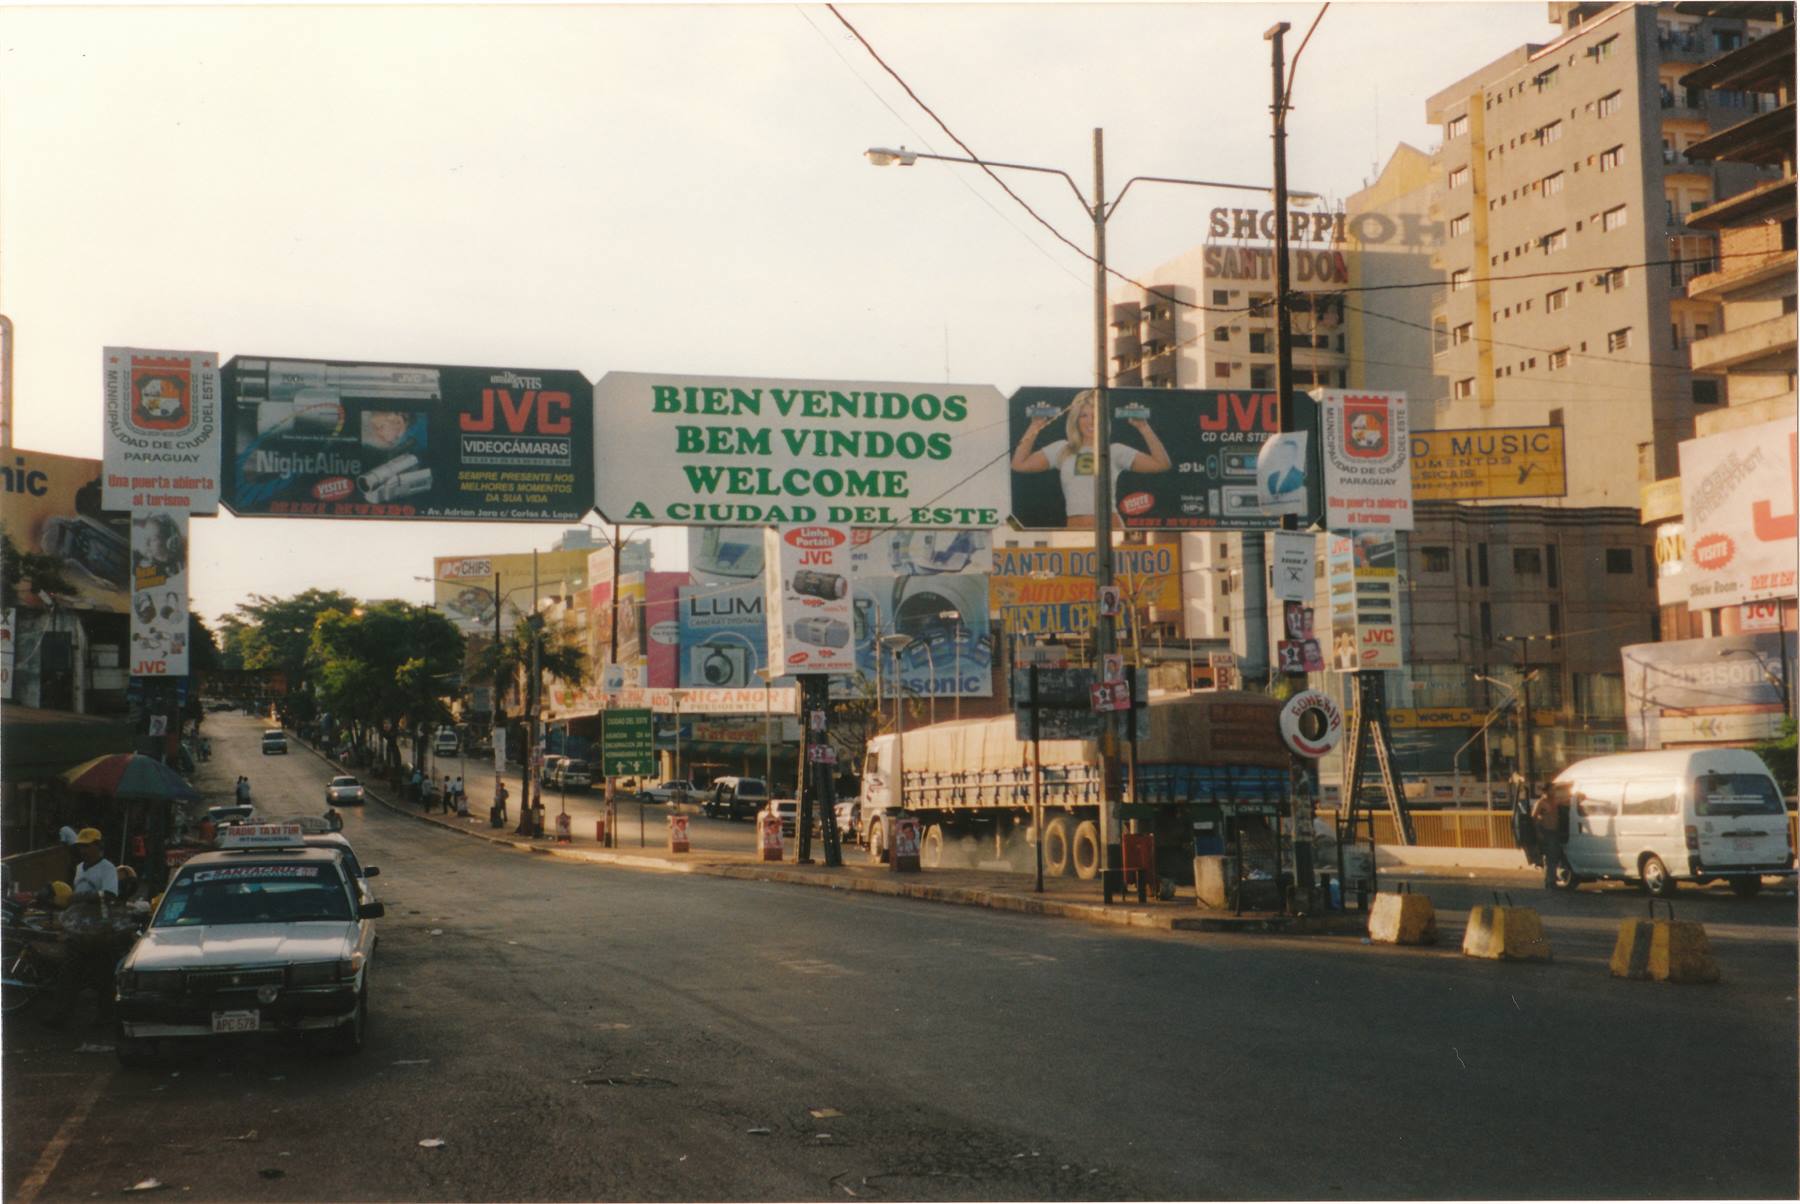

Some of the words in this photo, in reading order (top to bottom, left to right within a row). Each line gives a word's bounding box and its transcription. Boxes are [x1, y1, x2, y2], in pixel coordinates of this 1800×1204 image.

[202, 373, 214, 400] ESTE
[107, 369, 148, 450] MUNICIPALIDAD
[202, 402, 214, 422] DEL
[459, 388, 572, 434] JVC
[175, 423, 214, 450] CIUDAD
[676, 425, 772, 455] BEM
[781, 428, 953, 460] VINDOS
[1202, 432, 1217, 442] CD
[1220, 432, 1244, 442] CAR
[151, 440, 171, 450] DE
[1452, 433, 1550, 456] MUSIC
[123, 453, 201, 464] PARAGUAY
[458, 471, 497, 481] SEMPRE
[500, 472, 550, 482] PRESENTE
[1360, 467, 1377, 475] DE
[108, 475, 129, 488] Una
[131, 475, 170, 491] puerta
[172, 475, 214, 489] abierta
[683, 465, 910, 498] WELCOME
[1339, 477, 1397, 486] PARAGUAY
[132, 494, 144, 506] al
[146, 494, 191, 507] turismo
[485, 493, 500, 503] DA
[502, 494, 522, 503] SUA
[525, 494, 548, 503] VIDA
[626, 501, 654, 520] A
[666, 502, 817, 523] CIUDAD
[828, 506, 898, 524] DEL
[910, 507, 999, 526] ESTE
[801, 527, 829, 538] Linha
[799, 551, 833, 565] JVC
[992, 551, 1064, 577] SANTO
[463, 559, 491, 575] CHIPS
[1690, 582, 1711, 597] Show
[1714, 581, 1738, 593] Room
[1363, 629, 1395, 643] JVC
[133, 660, 166, 674] JVC
[1420, 712, 1472, 723] WORLD
[228, 827, 256, 836] RADIO
[259, 827, 281, 835] TAXI
